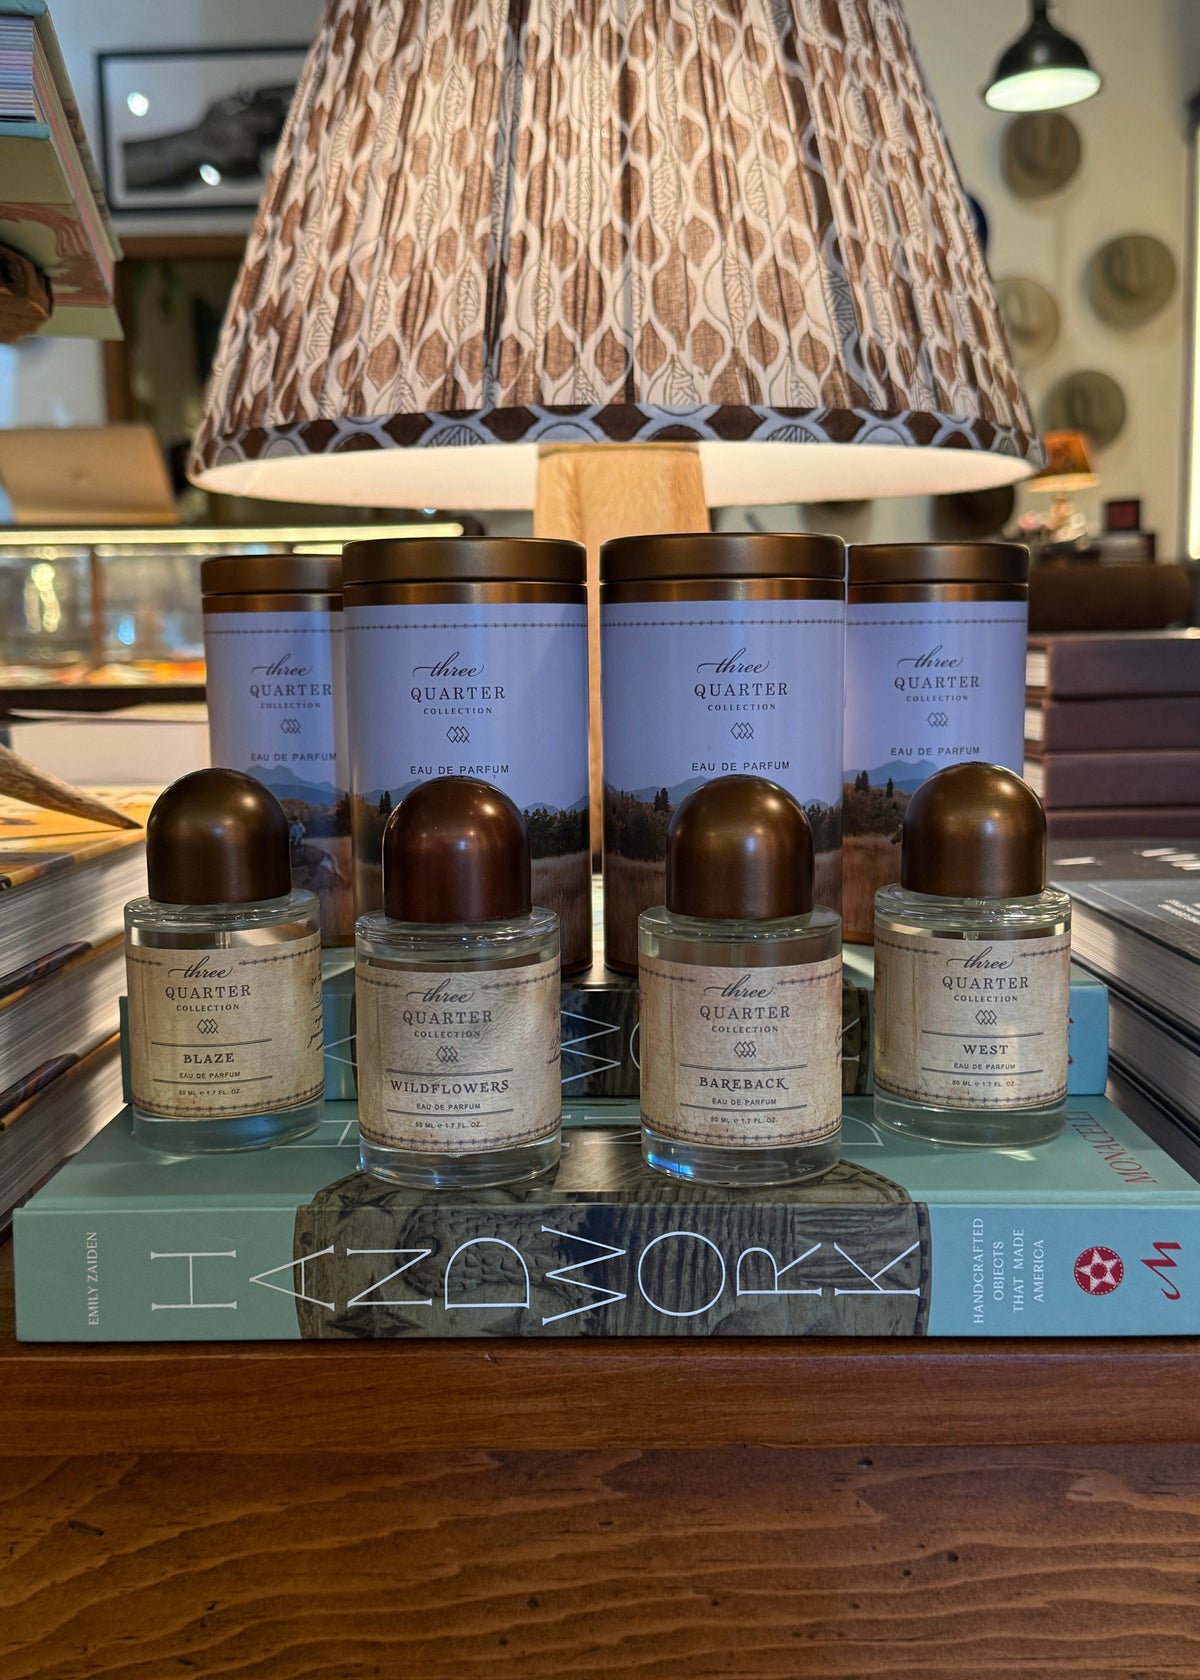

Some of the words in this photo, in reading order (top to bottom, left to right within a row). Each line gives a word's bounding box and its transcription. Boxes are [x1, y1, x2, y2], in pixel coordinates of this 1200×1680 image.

[251, 653, 314, 676] three
[412, 651, 484, 678] three
[696, 647, 770, 674] three
[896, 644, 963, 669] three
[250, 683, 332, 698] QUARTER
[694, 682, 788, 699] QUARTER
[894, 675, 980, 691] QUARTER
[411, 685, 506, 702] QUARTER
[905, 694, 968, 702] COLLECTION
[423, 707, 492, 715] COLLECTION
[707, 703, 776, 712] COLLECTION
[250, 753, 270, 761] EAU
[274, 753, 288, 761] DE
[292, 753, 337, 761] PARFUM
[890, 747, 913, 757] EAU
[917, 747, 934, 757] DE
[938, 746, 980, 756] PARFUM
[410, 765, 433, 775] EAU
[438, 765, 454, 775] DE
[459, 765, 510, 775] PARFUM
[691, 761, 715, 772] EAU
[721, 761, 737, 772] DE
[743, 761, 790, 771] PARFUM
[945, 945, 1015, 970] three
[167, 955, 233, 979] three
[405, 978, 475, 1003] three
[703, 973, 775, 998] three
[942, 975, 1029, 991] QUARTER
[165, 984, 251, 1000] QUARTER
[953, 994, 1018, 1003] COLLECTION
[176, 1003, 240, 1012] COLLECTION
[699, 1005, 791, 1021] QUARTER
[402, 1010, 493, 1025] QUARTER
[414, 1030, 481, 1039] COLLECTION
[711, 1025, 779, 1034] COLLECTION
[962, 1044, 1008, 1055] WEST
[183, 1052, 235, 1064] BLAZE
[209, 1071, 241, 1079] PARFUM
[390, 1079, 510, 1095] WILDFLOWERS
[699, 1076, 790, 1092] BAREBACK
[730, 1098, 742, 1106] DE
[744, 1098, 777, 1106] PARFUM
[86, 1231, 98, 1283] ZAIDEN
[1013, 1229, 1024, 1270] MADE
[151, 1224, 920, 1326] HANDWORK
[972, 1218, 984, 1324] HANDCRAFTED
[992, 1241, 1005, 1301] OBJECTS
[1033, 1239, 1044, 1303] AMERICA
[1013, 1277, 1024, 1313] THAT
[87, 1286, 99, 1326] EMILY
